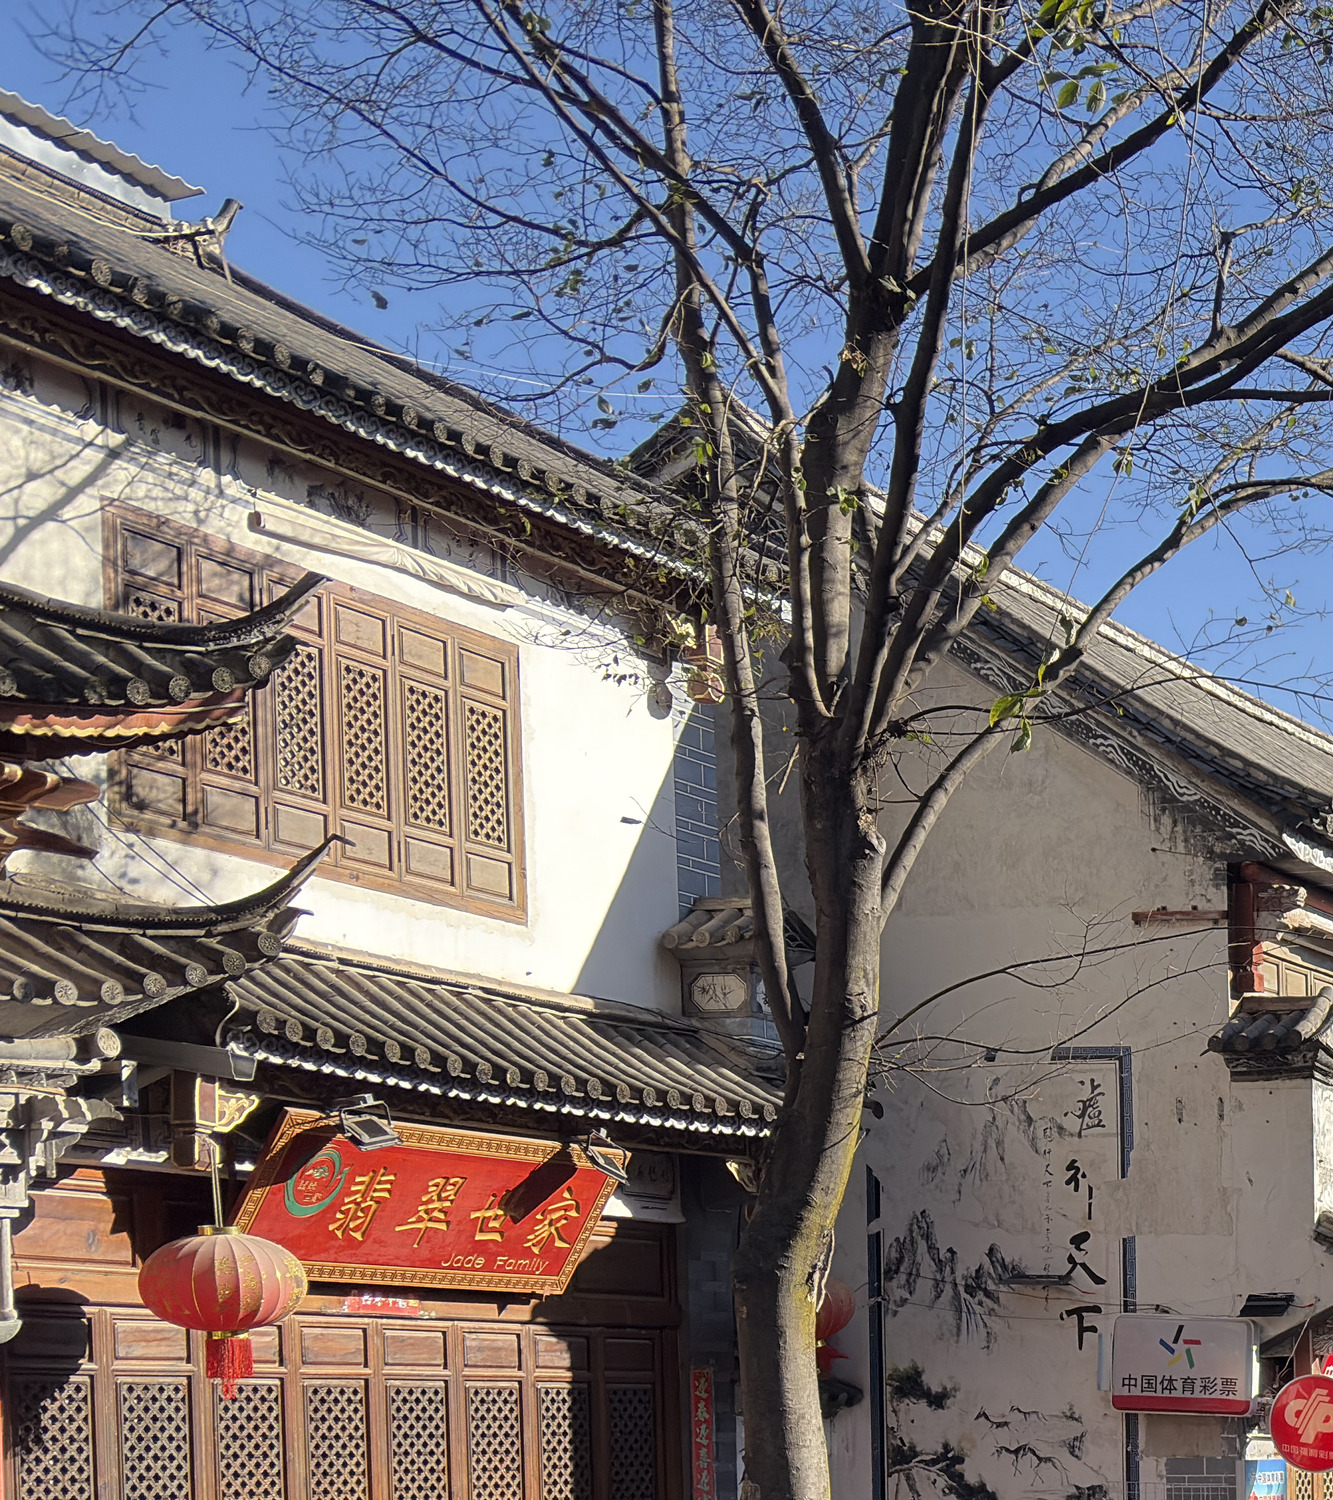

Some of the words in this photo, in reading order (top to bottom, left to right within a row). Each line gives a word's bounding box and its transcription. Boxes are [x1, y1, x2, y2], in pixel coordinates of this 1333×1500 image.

[328, 1166, 582, 1255] 翡翠世家
[441, 1252, 486, 1270] Jade
[494, 1255, 550, 1276] Family
[1121, 1373, 1239, 1397] 中国体育彩票
